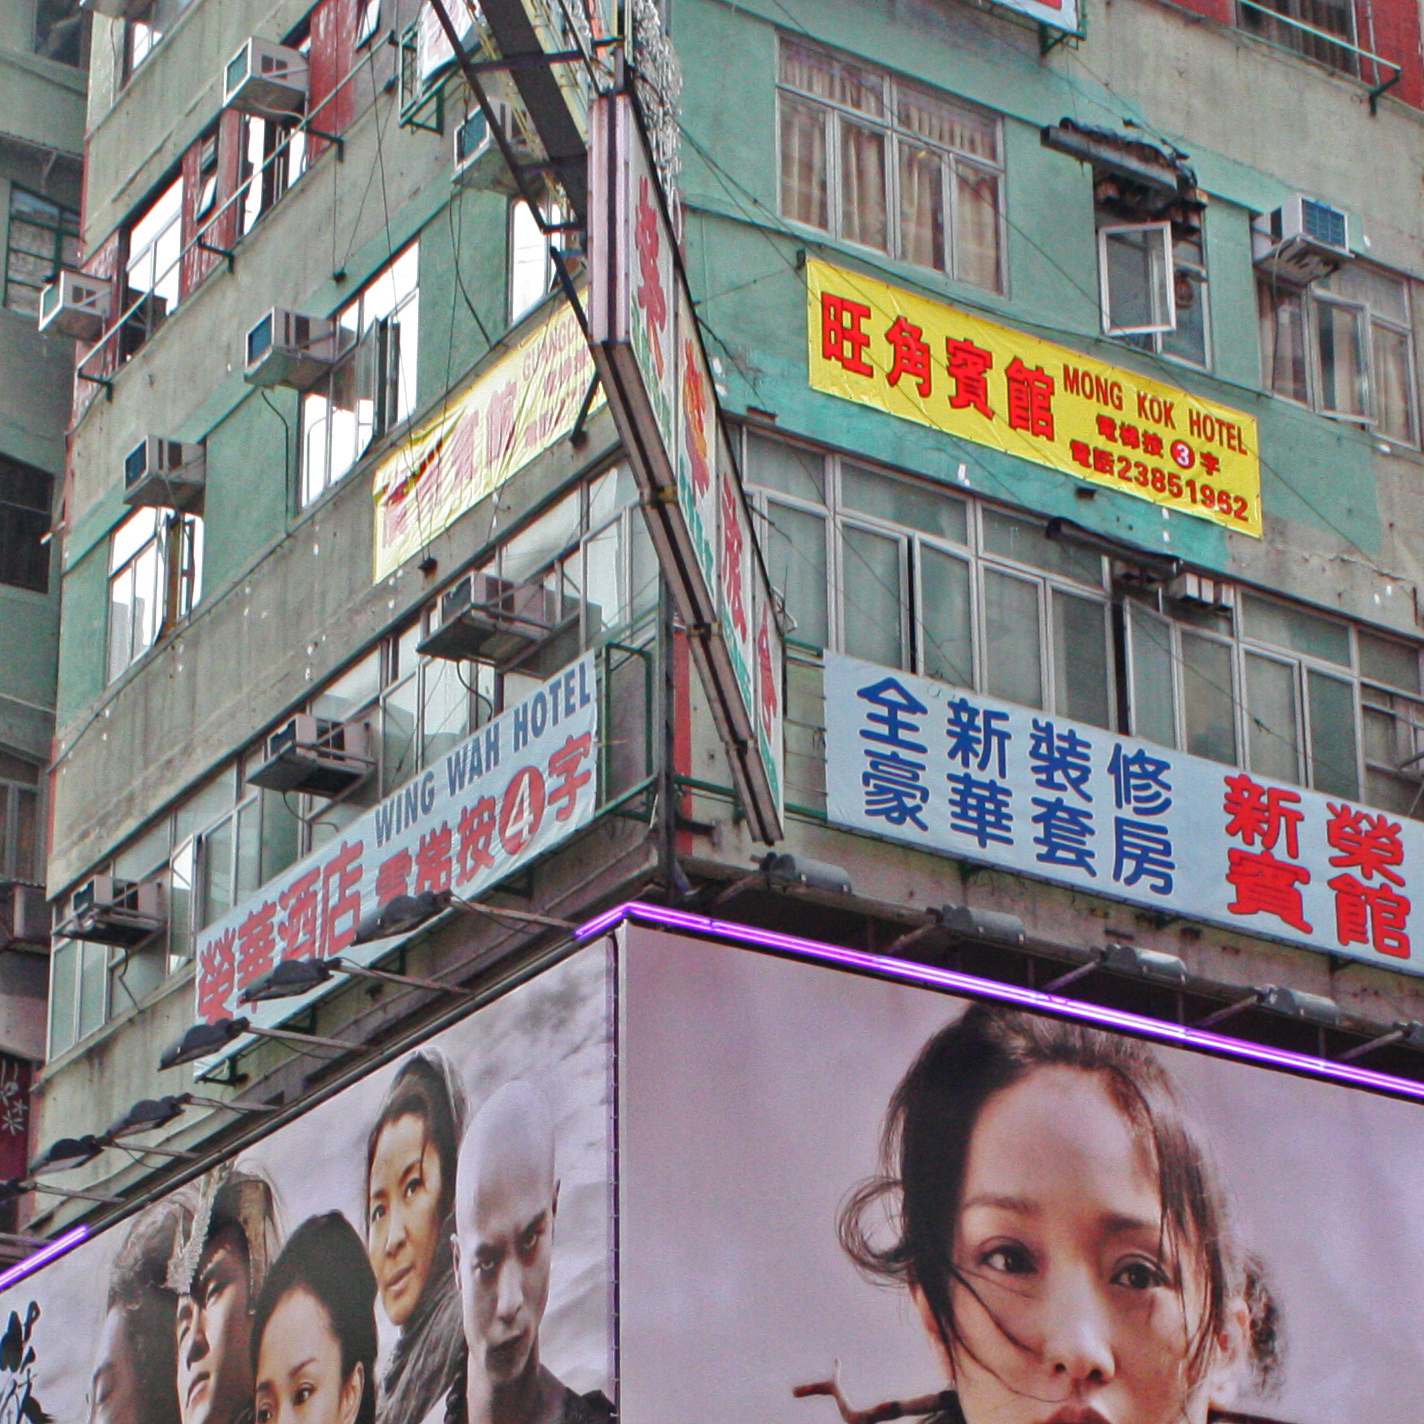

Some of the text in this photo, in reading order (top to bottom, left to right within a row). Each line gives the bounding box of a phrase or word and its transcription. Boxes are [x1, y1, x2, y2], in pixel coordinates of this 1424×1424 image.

[821, 292, 1056, 442] 旺角賓館
[1063, 363, 1248, 455] MONG KOK HOTEL
[1069, 438, 1249, 522] 電話23851962
[374, 663, 592, 849] WING WAH HOTEL
[857, 677, 1174, 818] 全新裝修
[861, 749, 1176, 895] 豪華套房
[198, 840, 365, 1023] 榮華酒店
[1226, 847, 1412, 960] 賓館
